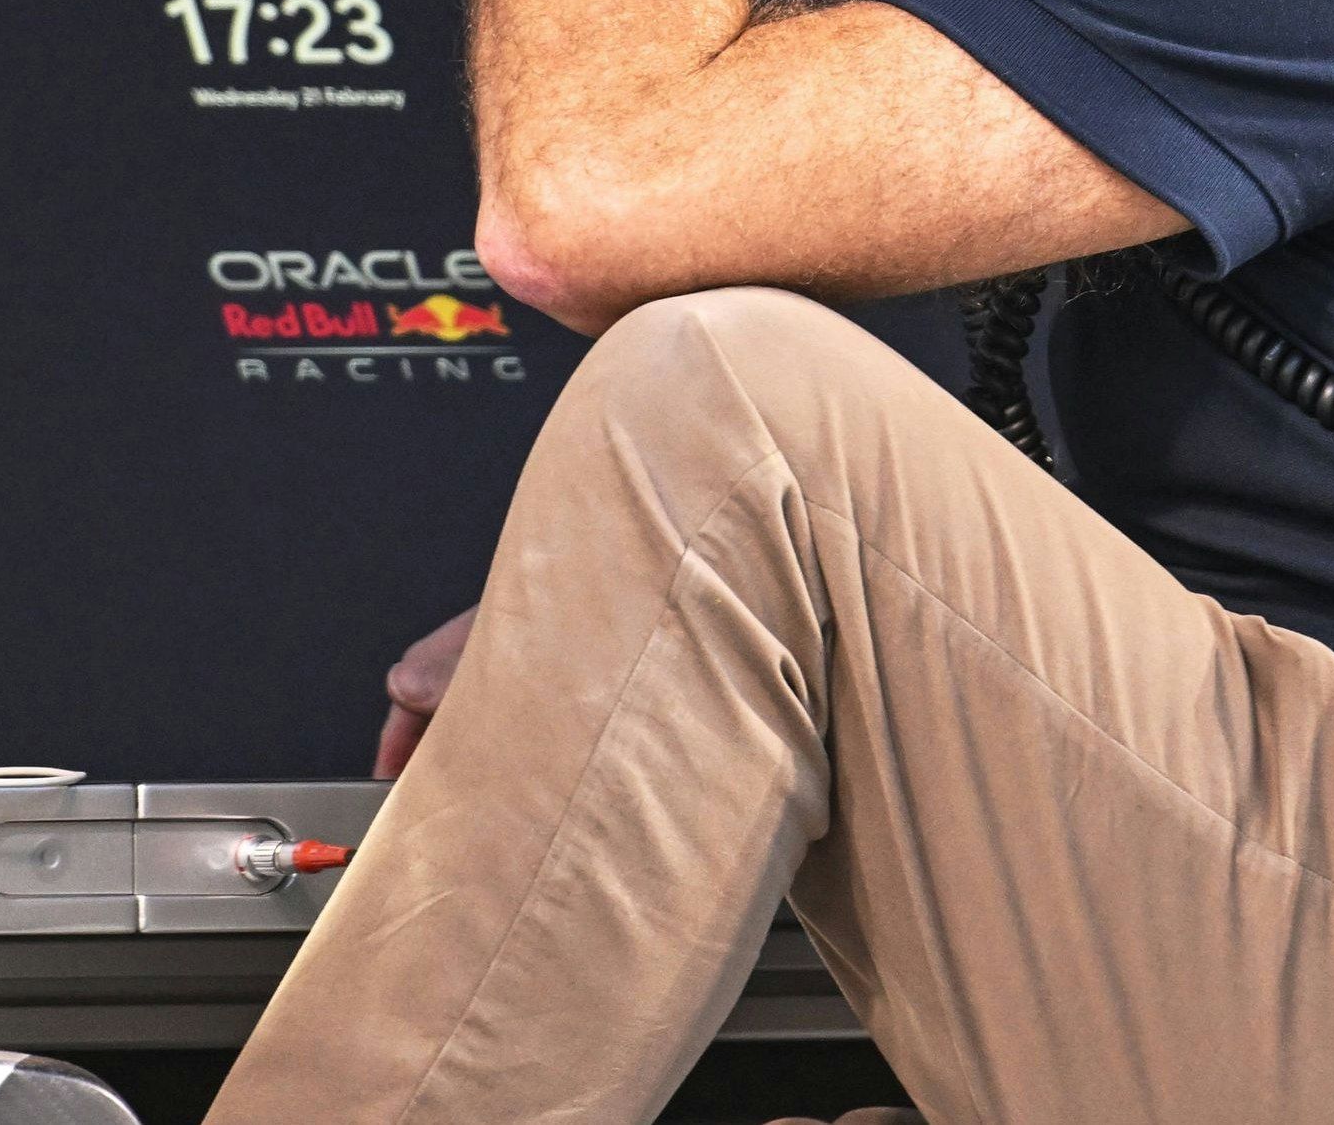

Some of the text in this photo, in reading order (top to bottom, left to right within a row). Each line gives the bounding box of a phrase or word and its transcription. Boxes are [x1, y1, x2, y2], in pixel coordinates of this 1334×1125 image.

[190, 86, 300, 111] Wednesday
[323, 86, 407, 111] February
[207, 249, 499, 292] ORACLE
[221, 300, 381, 339] Red Bull
[234, 356, 527, 382] RACING
